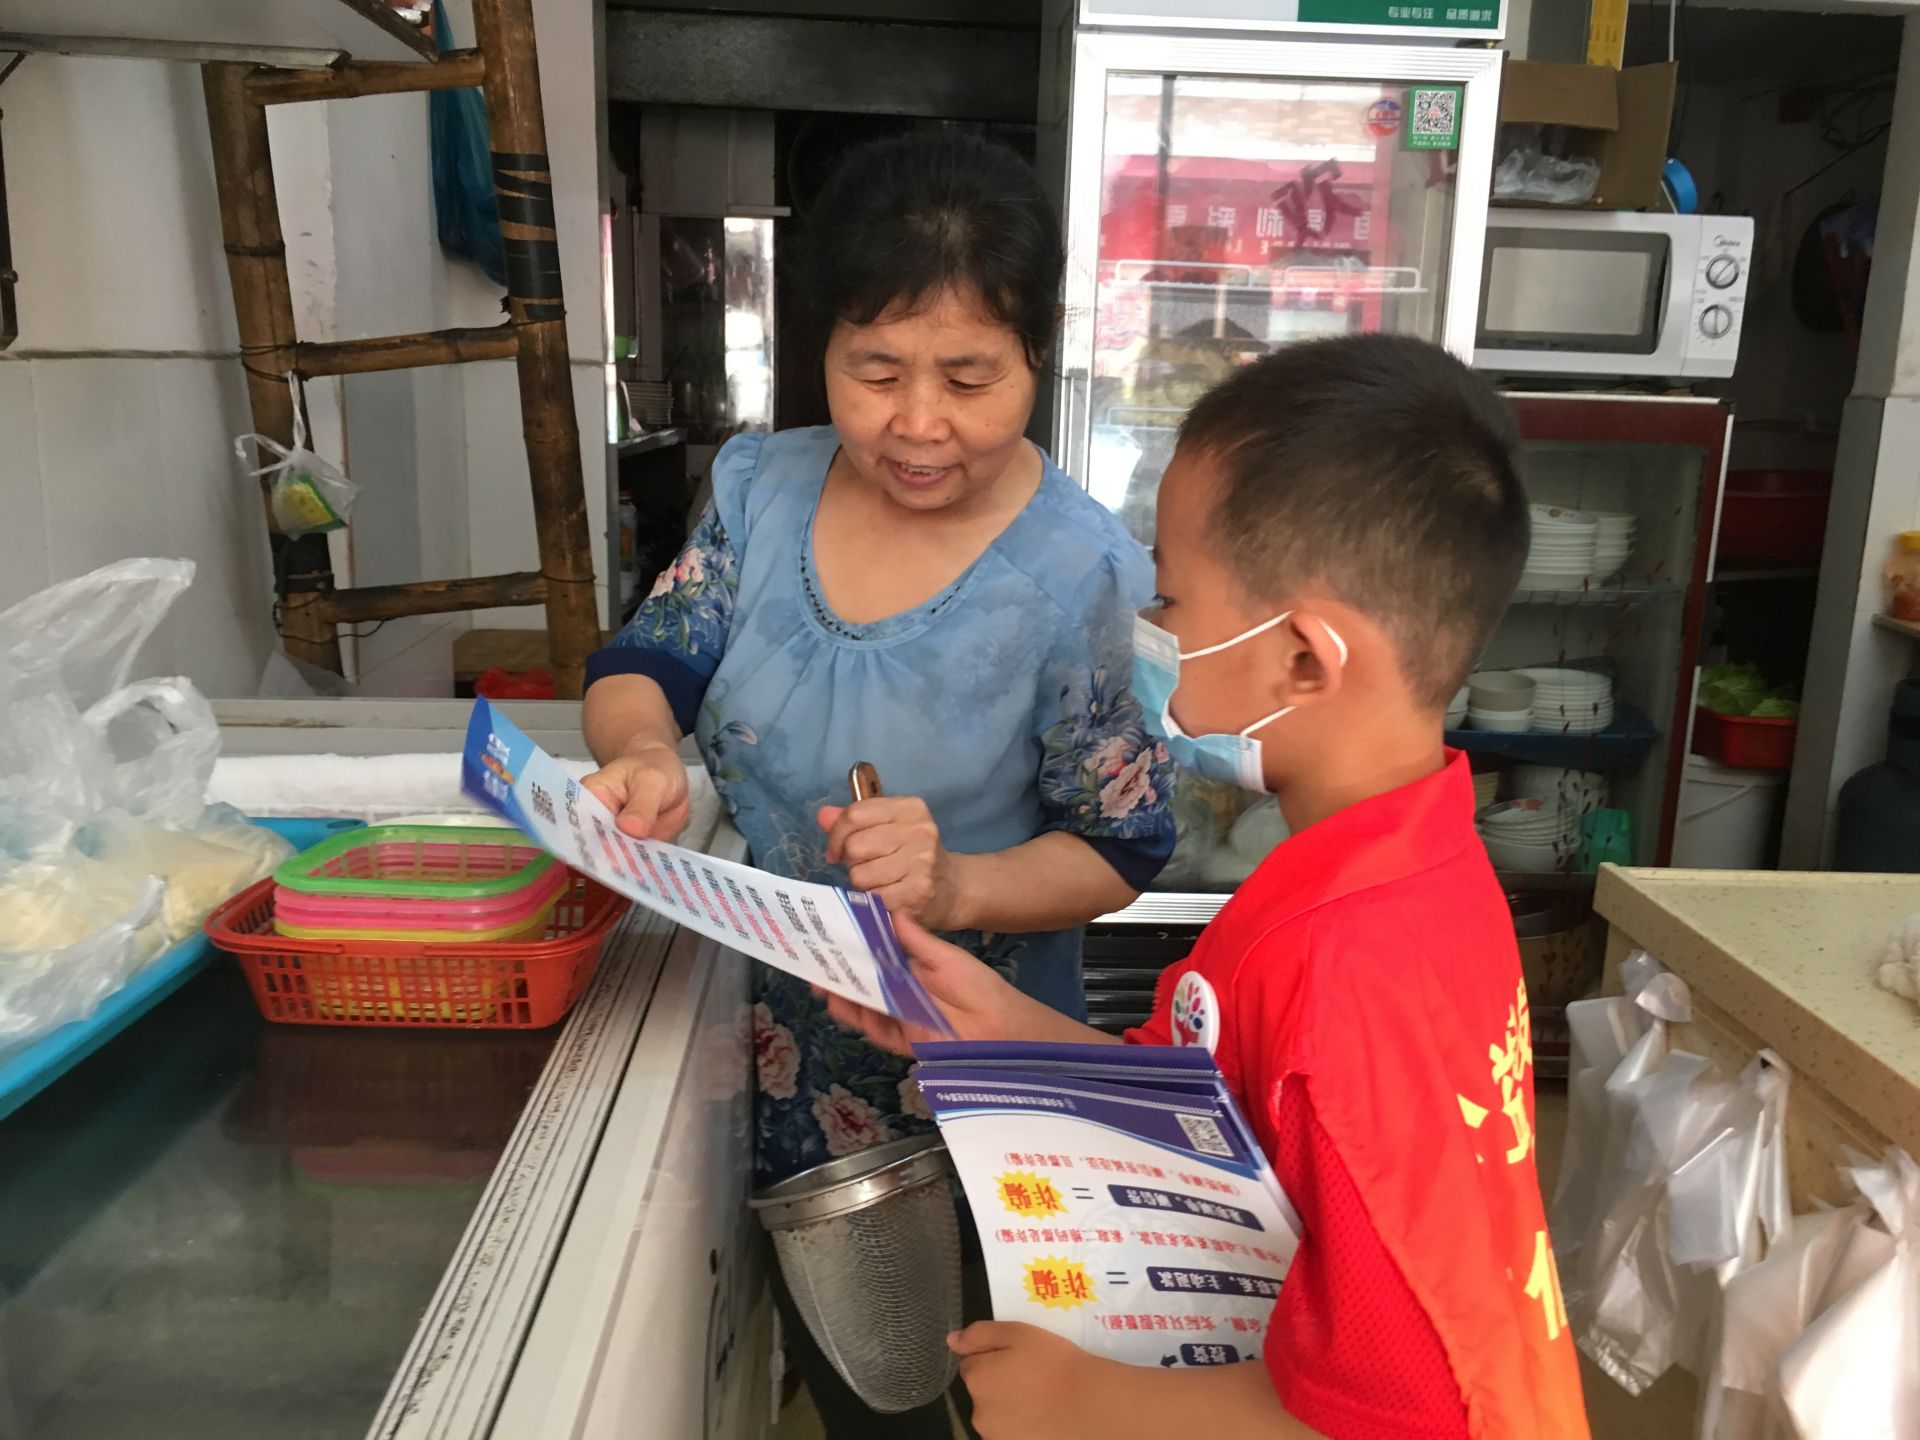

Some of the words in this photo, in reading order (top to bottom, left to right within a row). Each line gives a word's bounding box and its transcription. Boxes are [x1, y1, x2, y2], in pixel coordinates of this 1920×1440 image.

[1003, 1182, 1057, 1212] 诈骗
[1031, 1267, 1088, 1301] 诈骗
[1190, 1344, 1228, 1364] 投资
